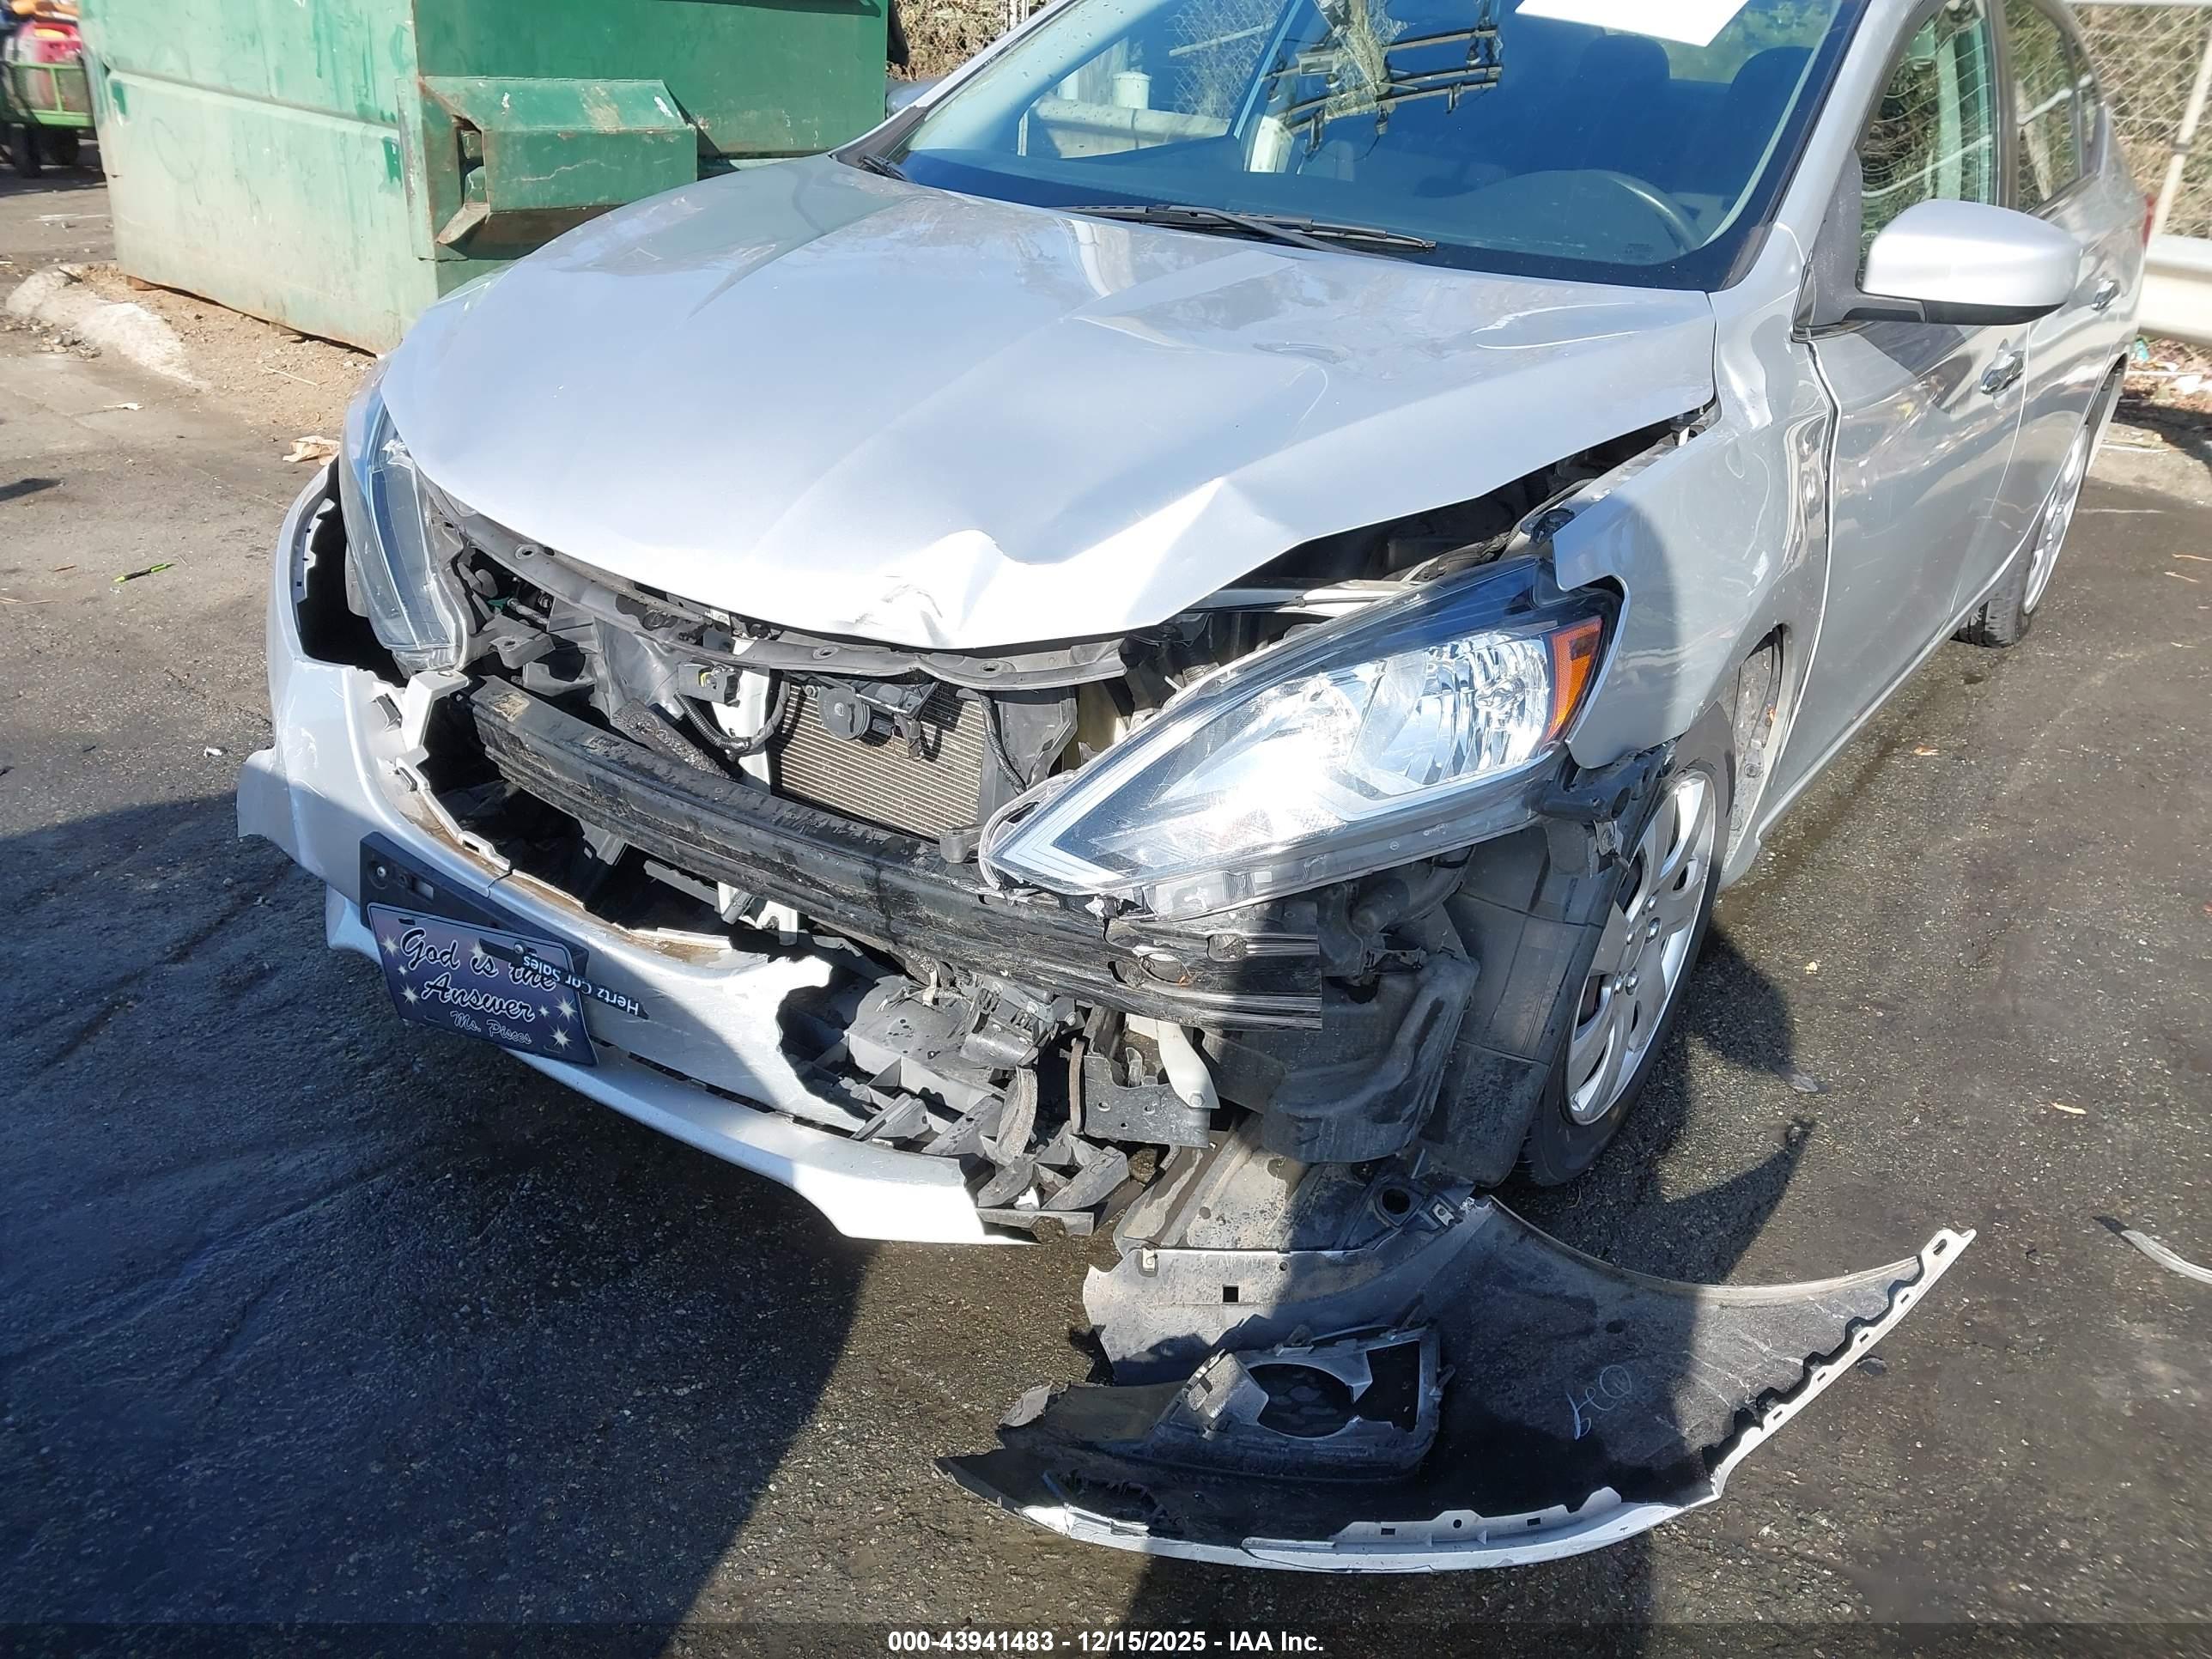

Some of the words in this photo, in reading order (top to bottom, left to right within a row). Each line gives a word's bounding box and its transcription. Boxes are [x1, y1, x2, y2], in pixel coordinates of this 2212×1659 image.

[400, 927, 461, 971] God
[470, 955, 499, 978] is
[523, 955, 562, 983] Sales
[421, 972, 536, 1023] Answer
[565, 974, 592, 995] Car
[597, 988, 640, 1016] Hertz
[486, 1018, 532, 1045] Pisces
